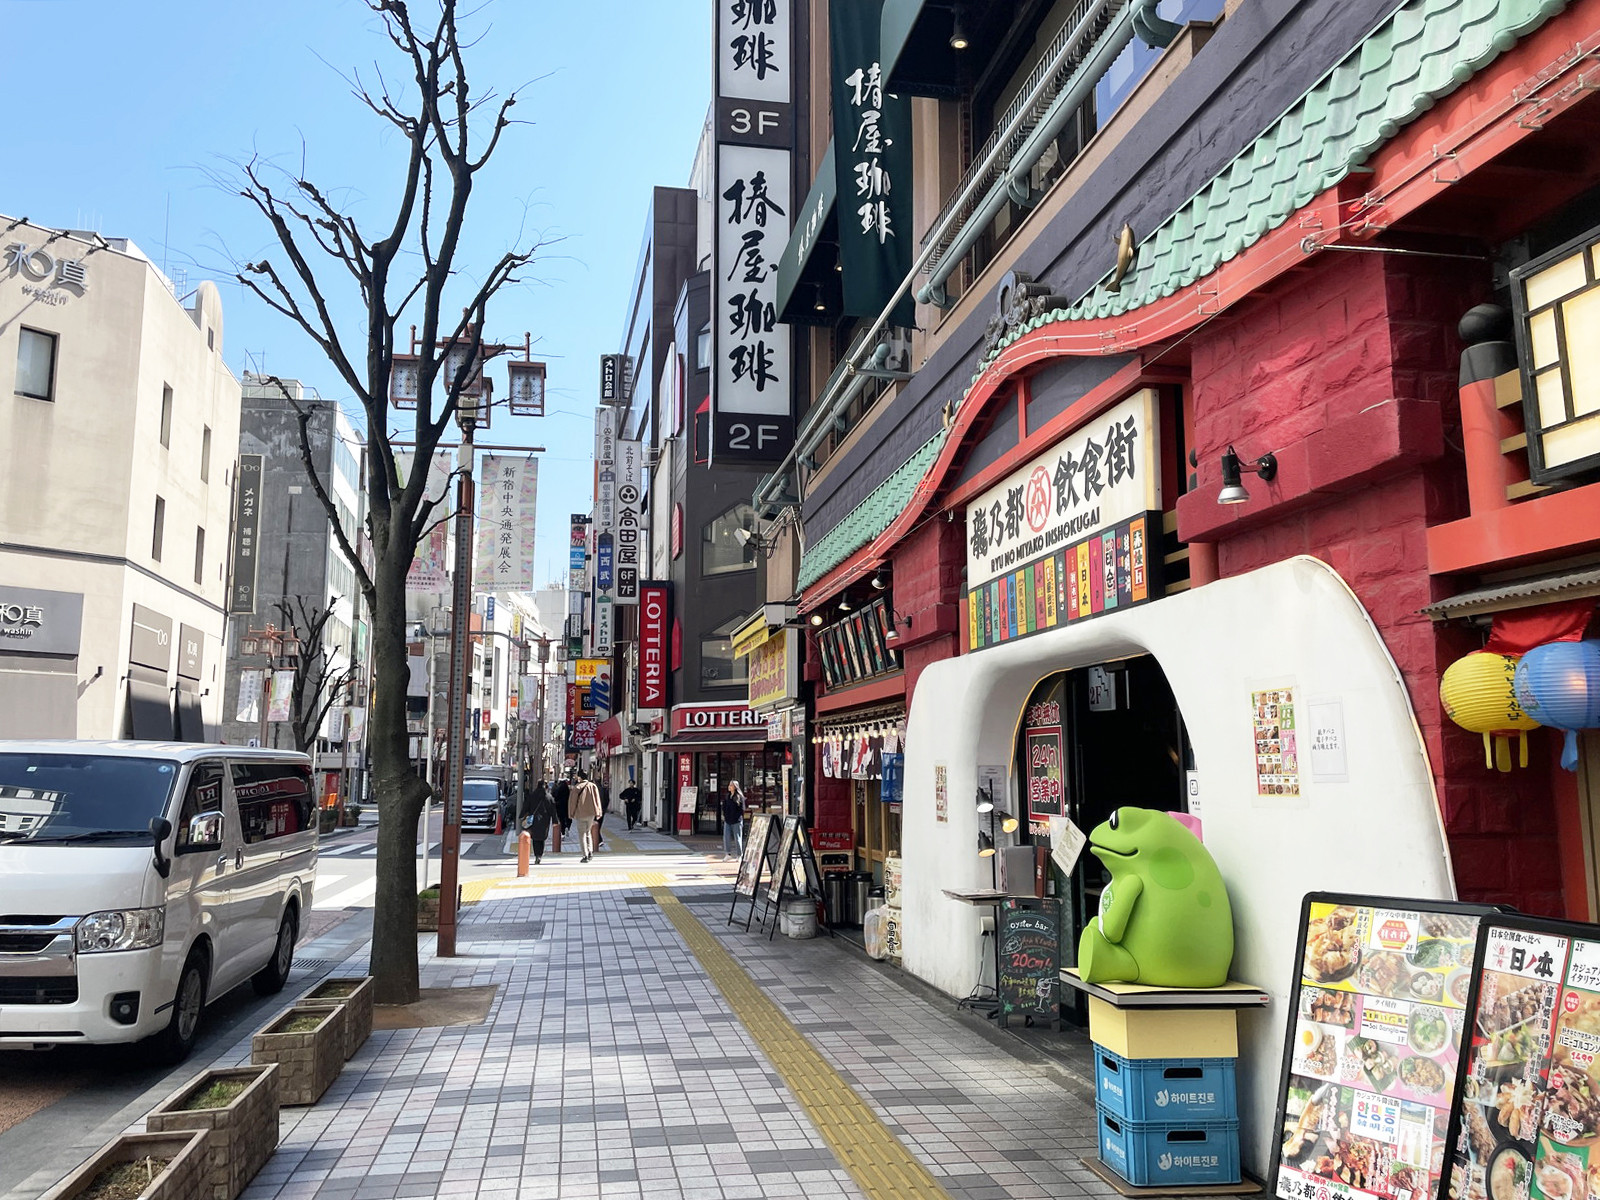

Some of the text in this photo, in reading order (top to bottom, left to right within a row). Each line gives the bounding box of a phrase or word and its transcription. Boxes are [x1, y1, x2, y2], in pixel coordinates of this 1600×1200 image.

[730, 108, 780, 135] 3F
[8, 242, 88, 292] 和真
[722, 170, 786, 392] 椿屋珈琲
[604, 359, 614, 398] メトロ会館
[728, 423, 780, 450] 2F
[970, 414, 1138, 560] 龍乃都 飲食街
[243, 487, 255, 517] メガネ
[498, 466, 516, 574] 新宿中央通発展会
[618, 506, 638, 565] 高田屋
[1016, 534, 1044, 562] MIYAKO
[1045, 506, 1100, 549] INSHOKUGAI
[620, 570, 634, 581] 6F
[620, 585, 634, 595] 7F
[645, 591, 661, 702] LOTTERIA
[1089, 686, 1103, 705] 2F
[686, 709, 768, 727] LOTTERIA
[1031, 743, 1057, 769] 24h
[1030, 775, 1061, 804] 営業中
[1010, 919, 1049, 931] oyster bar
[1556, 939, 1567, 949] 1F
[1574, 942, 1585, 952] 2F
[1510, 946, 1554, 978] 日ノ本
[1170, 1093, 1216, 1105] 하이트진로
[1173, 1155, 1219, 1168] 하이트진로
